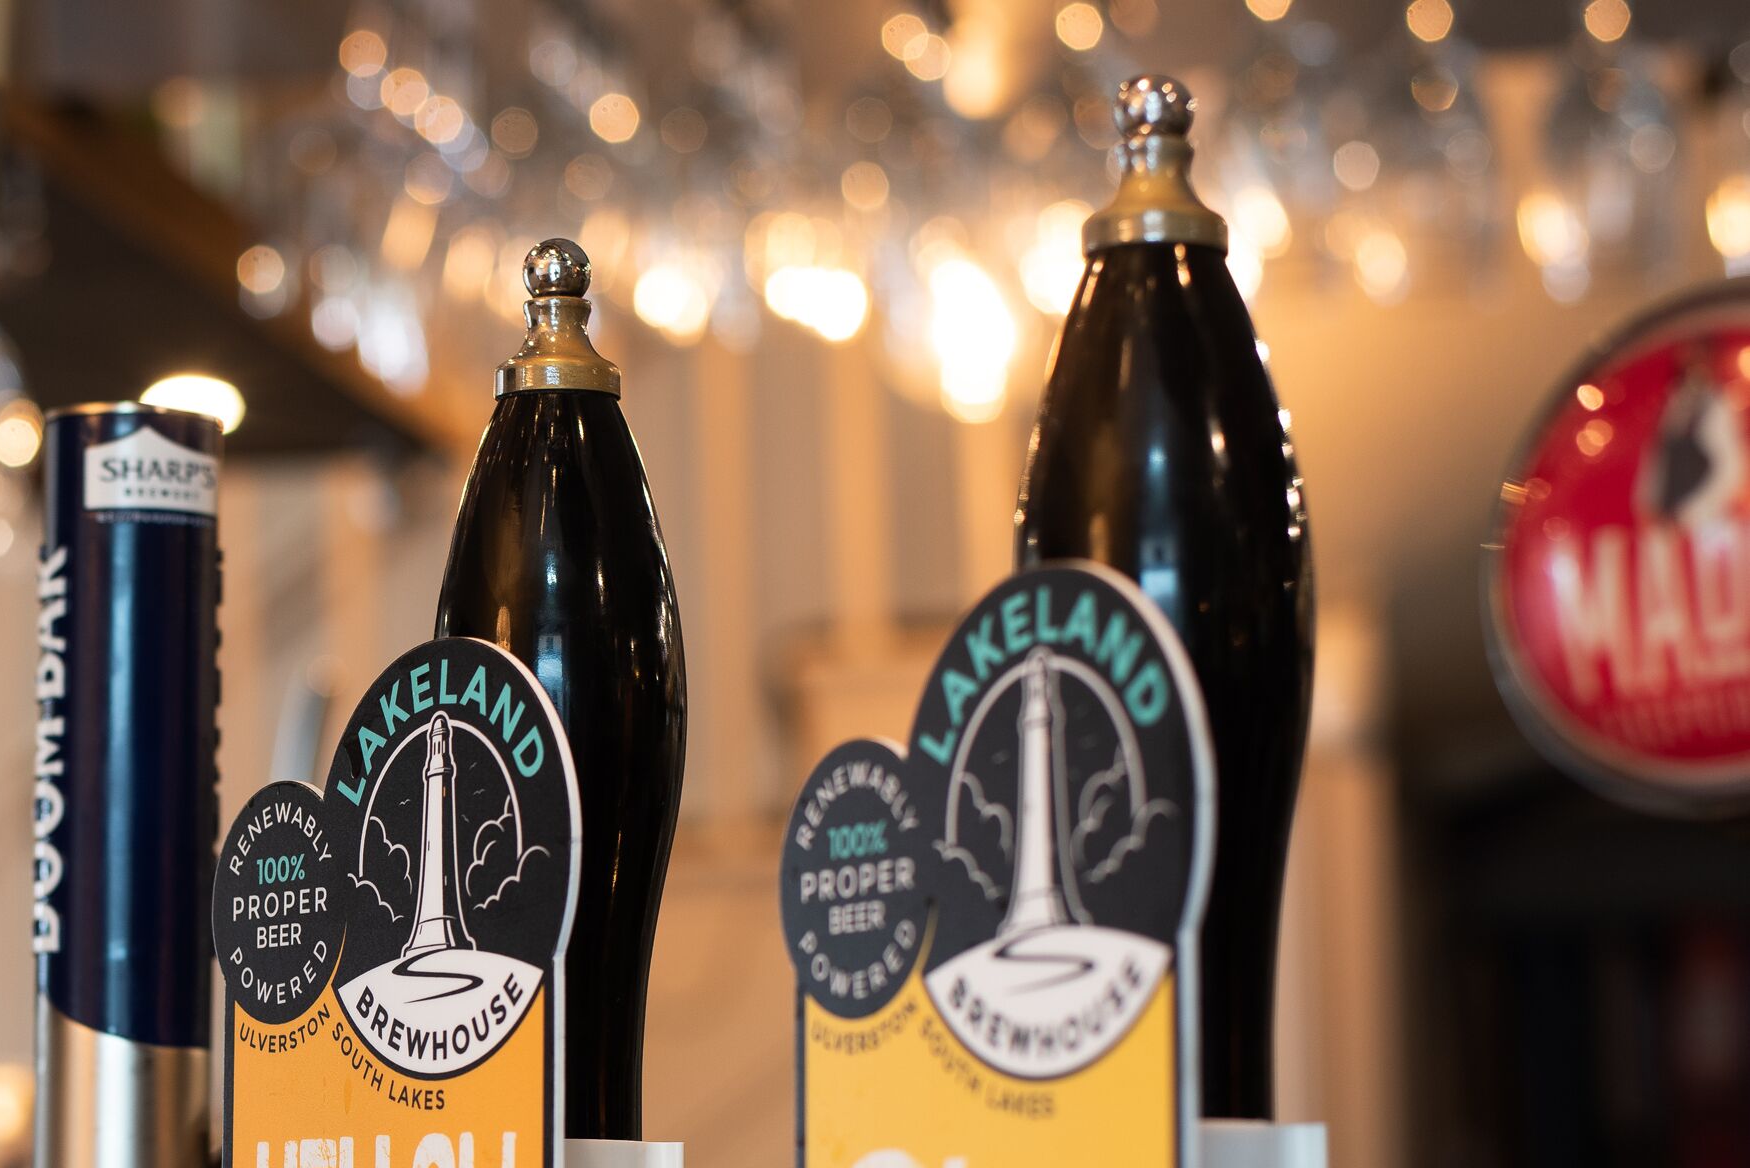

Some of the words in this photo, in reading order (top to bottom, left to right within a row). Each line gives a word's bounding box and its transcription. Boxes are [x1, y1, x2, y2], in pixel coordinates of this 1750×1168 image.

[100, 457, 217, 490] SHARP'S
[918, 584, 1170, 767] LAKELAND
[337, 658, 545, 807] LAKELAND
[230, 801, 333, 877] RENEWABLY
[795, 760, 920, 851] RENEWABLY
[827, 818, 888, 861] 100%
[232, 886, 329, 922] PROPER
[256, 853, 306, 886] 100%
[800, 856, 916, 905] PROPER
[256, 922, 303, 950] BEER
[828, 900, 886, 936] BEER
[229, 939, 329, 1006] POWERED
[798, 919, 917, 1000] POWERED
[356, 971, 524, 1061] BREWHOUSE
[947, 953, 1144, 1062] BREWHOUSE
[239, 1002, 331, 1053] ULVERSTON
[332, 1022, 384, 1092] SOUTH
[388, 1080, 445, 1111] LAKES
